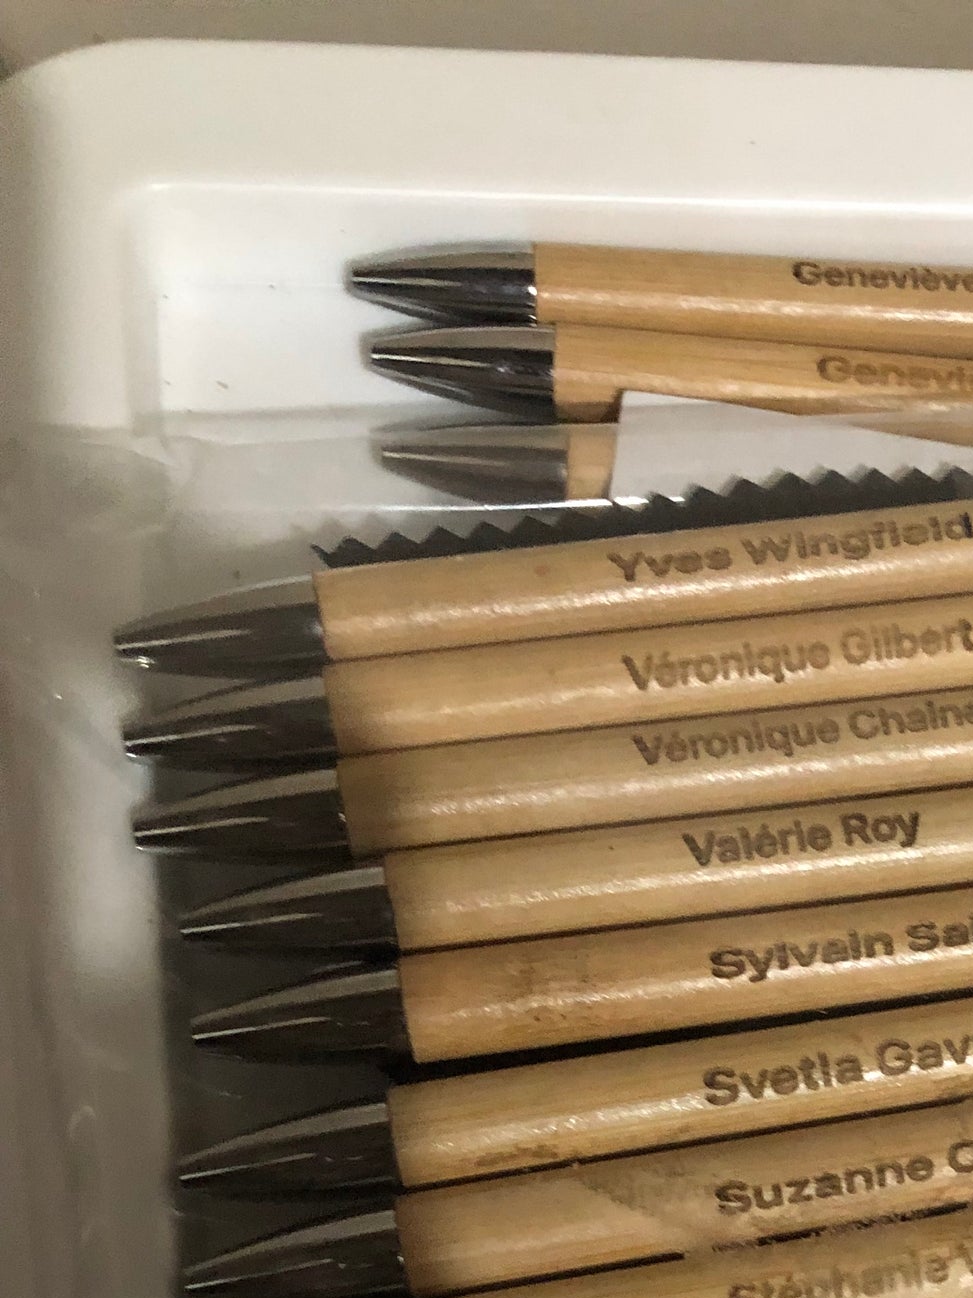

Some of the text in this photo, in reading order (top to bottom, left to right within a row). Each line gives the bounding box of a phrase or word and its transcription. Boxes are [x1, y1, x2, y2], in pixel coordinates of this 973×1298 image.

[606, 546, 733, 582] Yves
[621, 641, 831, 692] Véronique
[632, 716, 840, 765] Véronique
[682, 811, 920, 867] Valérie Roy
[708, 929, 895, 983] Sylvain
[702, 1049, 866, 1106] Svetla
[714, 1155, 935, 1215] Suzanne
